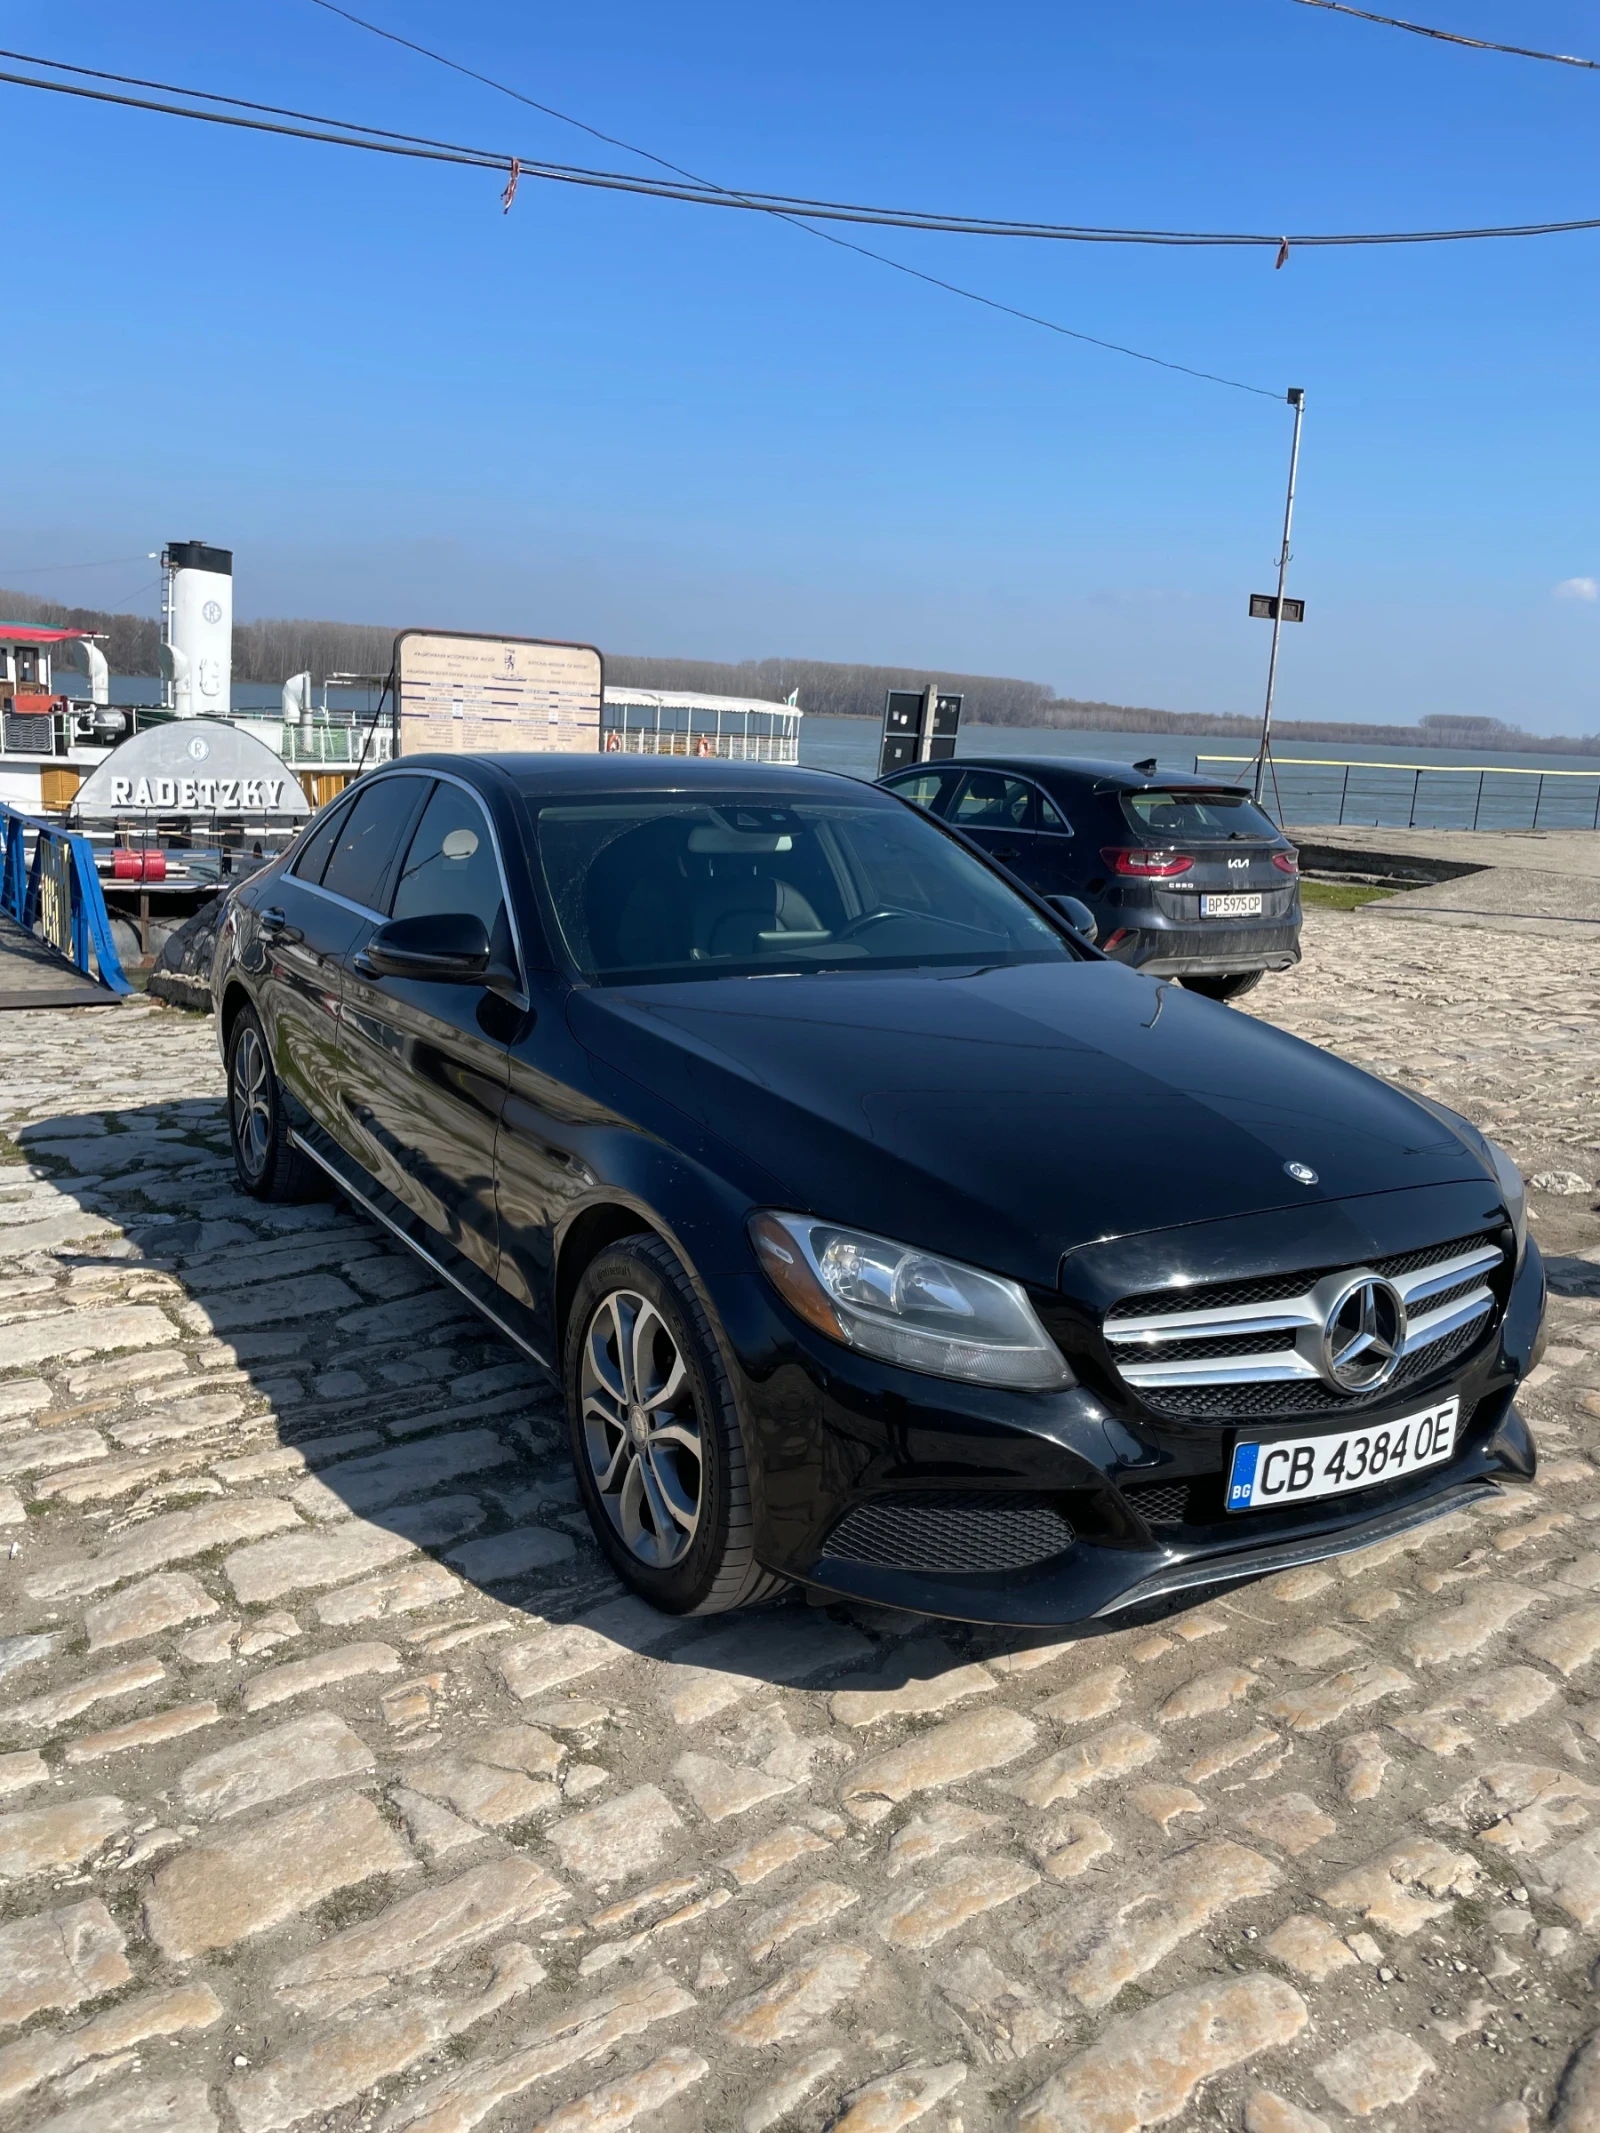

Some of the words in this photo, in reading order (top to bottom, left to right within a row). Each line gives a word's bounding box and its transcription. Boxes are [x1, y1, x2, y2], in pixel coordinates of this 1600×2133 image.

[110, 776, 285, 809] RADETZKY
[1208, 897, 1222, 912] BP
[1223, 897, 1247, 912] 5975
[1248, 896, 1261, 911] CP
[1260, 1446, 1316, 1496] CB
[1324, 1424, 1411, 1485] 4384
[1414, 1408, 1454, 1461] OE
[1232, 1484, 1252, 1500] BG
